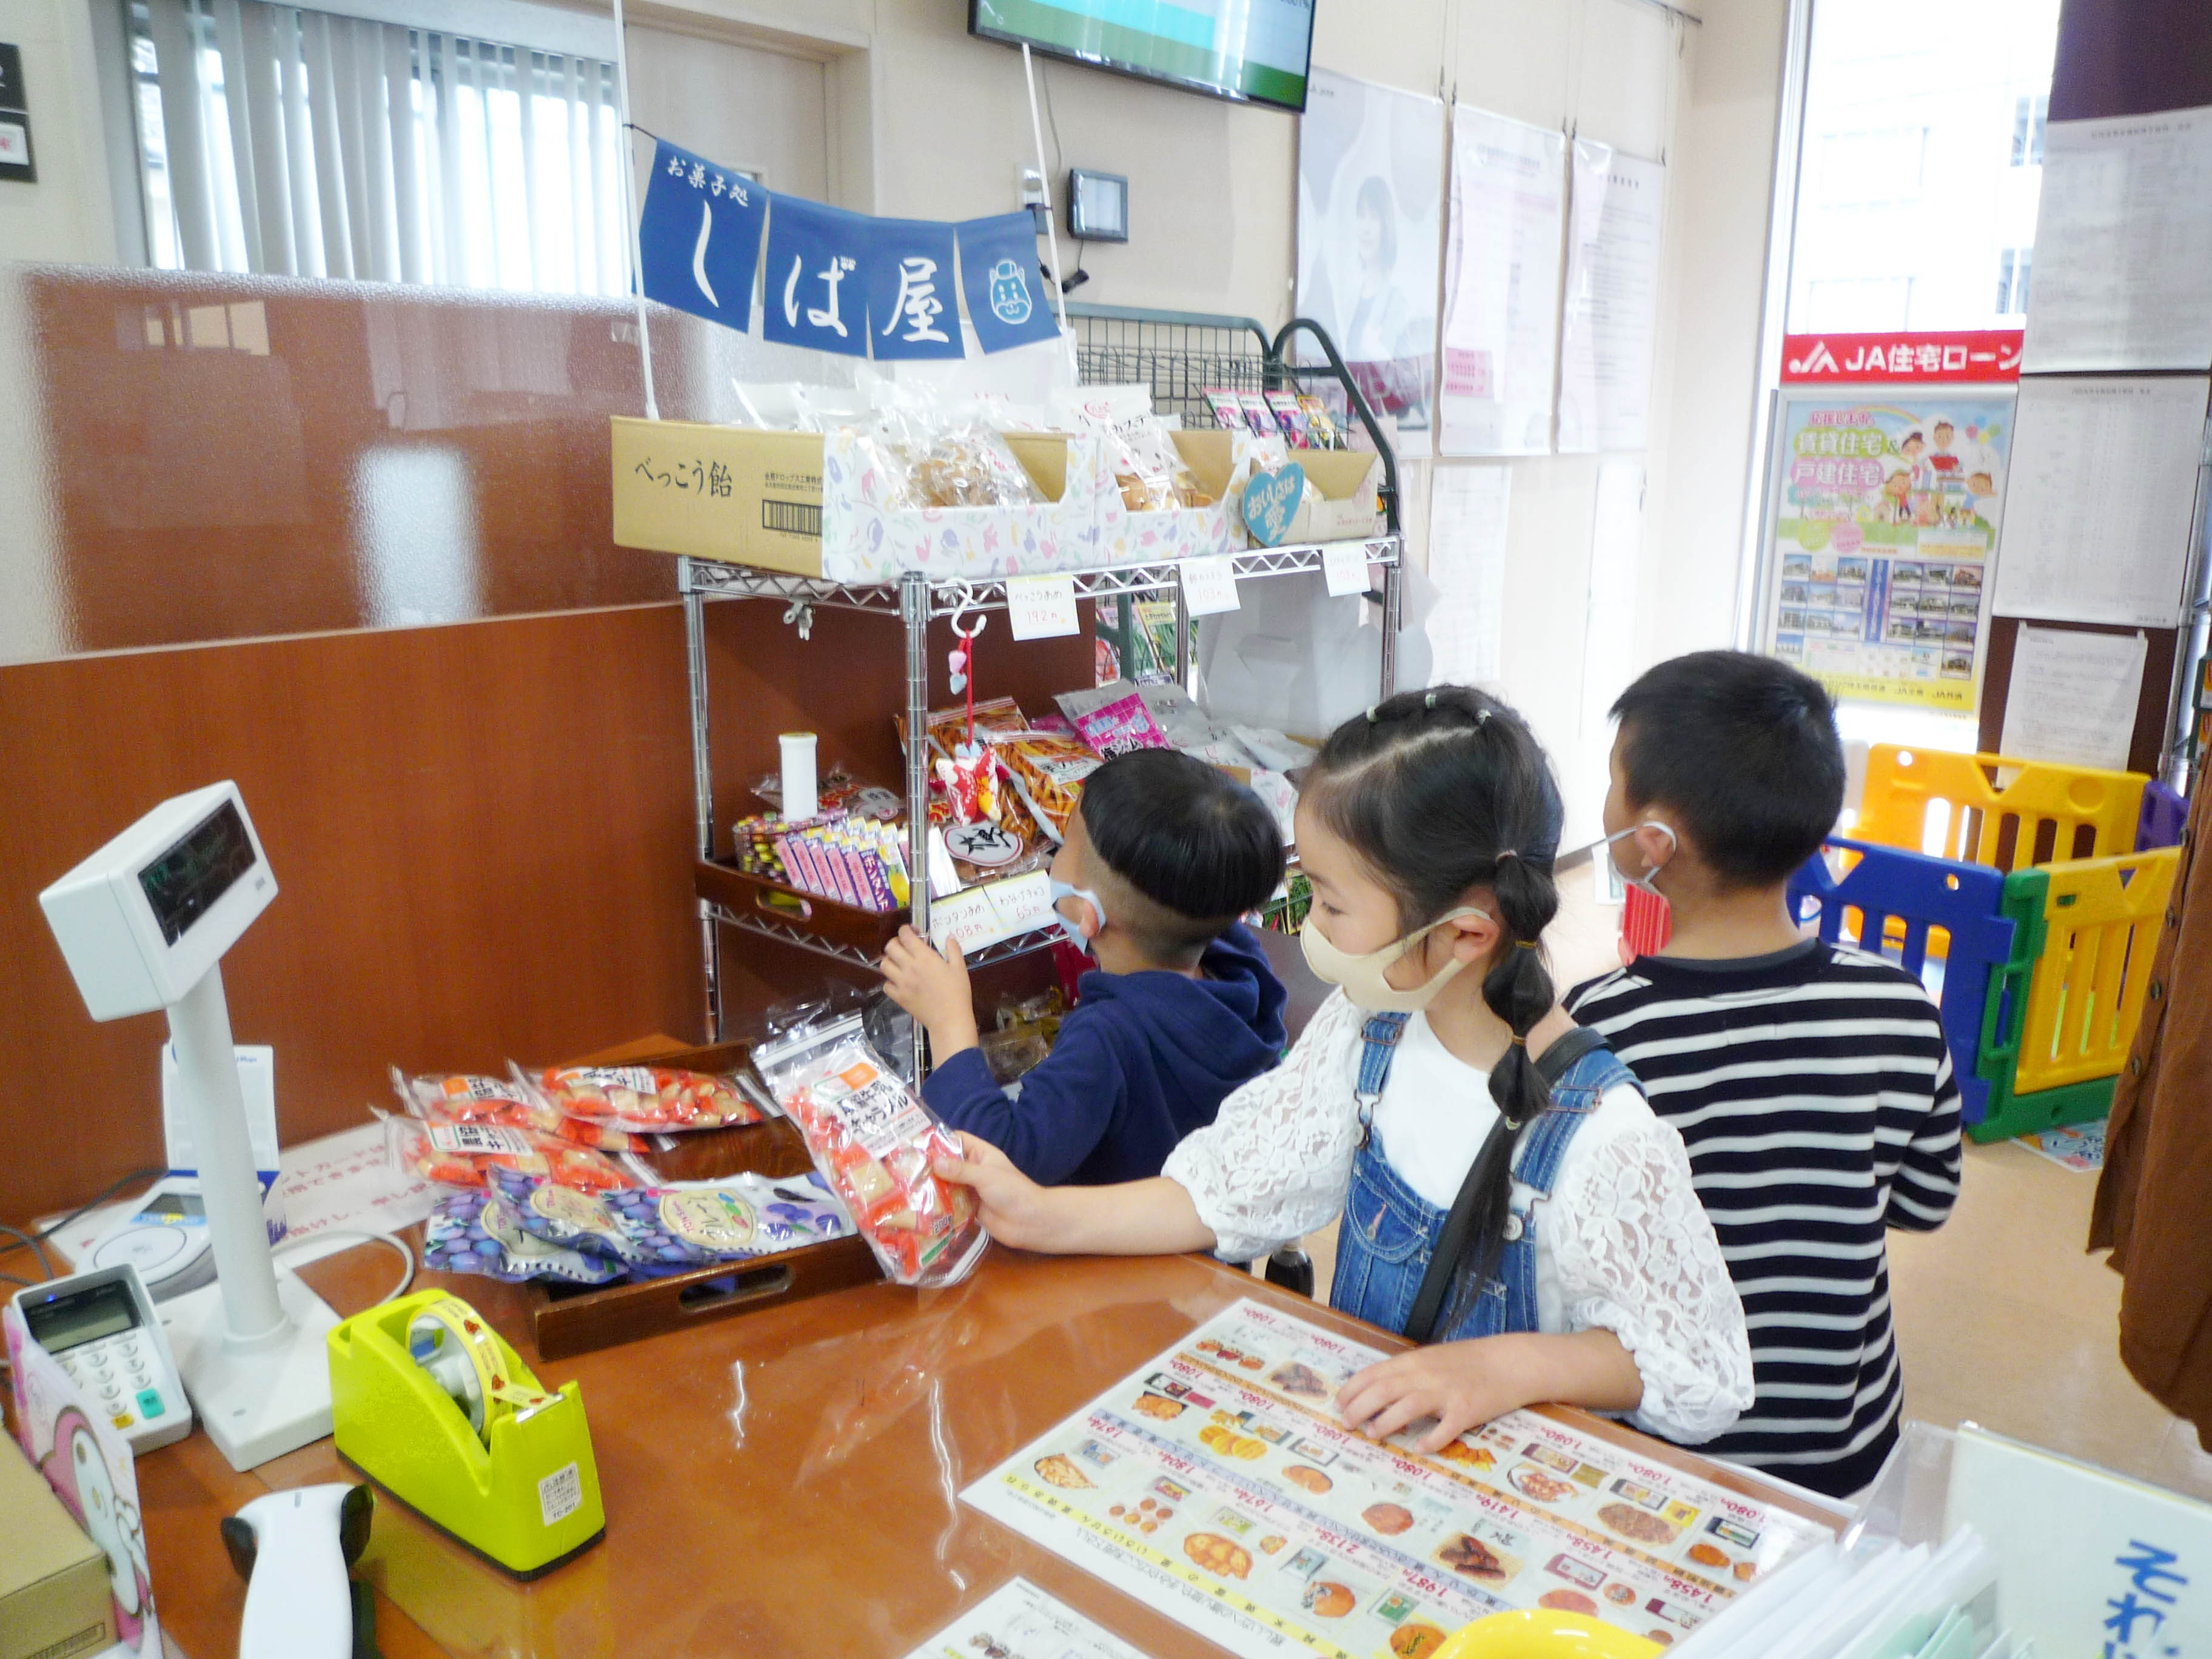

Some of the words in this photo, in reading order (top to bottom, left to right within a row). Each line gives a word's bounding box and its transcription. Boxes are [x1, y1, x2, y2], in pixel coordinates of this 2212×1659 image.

[668, 155, 749, 207] お菓子処
[635, 457, 732, 498] べっこう飴
[1795, 461, 1880, 486] 戸建住宅
[1027, 610, 1058, 624] 192円
